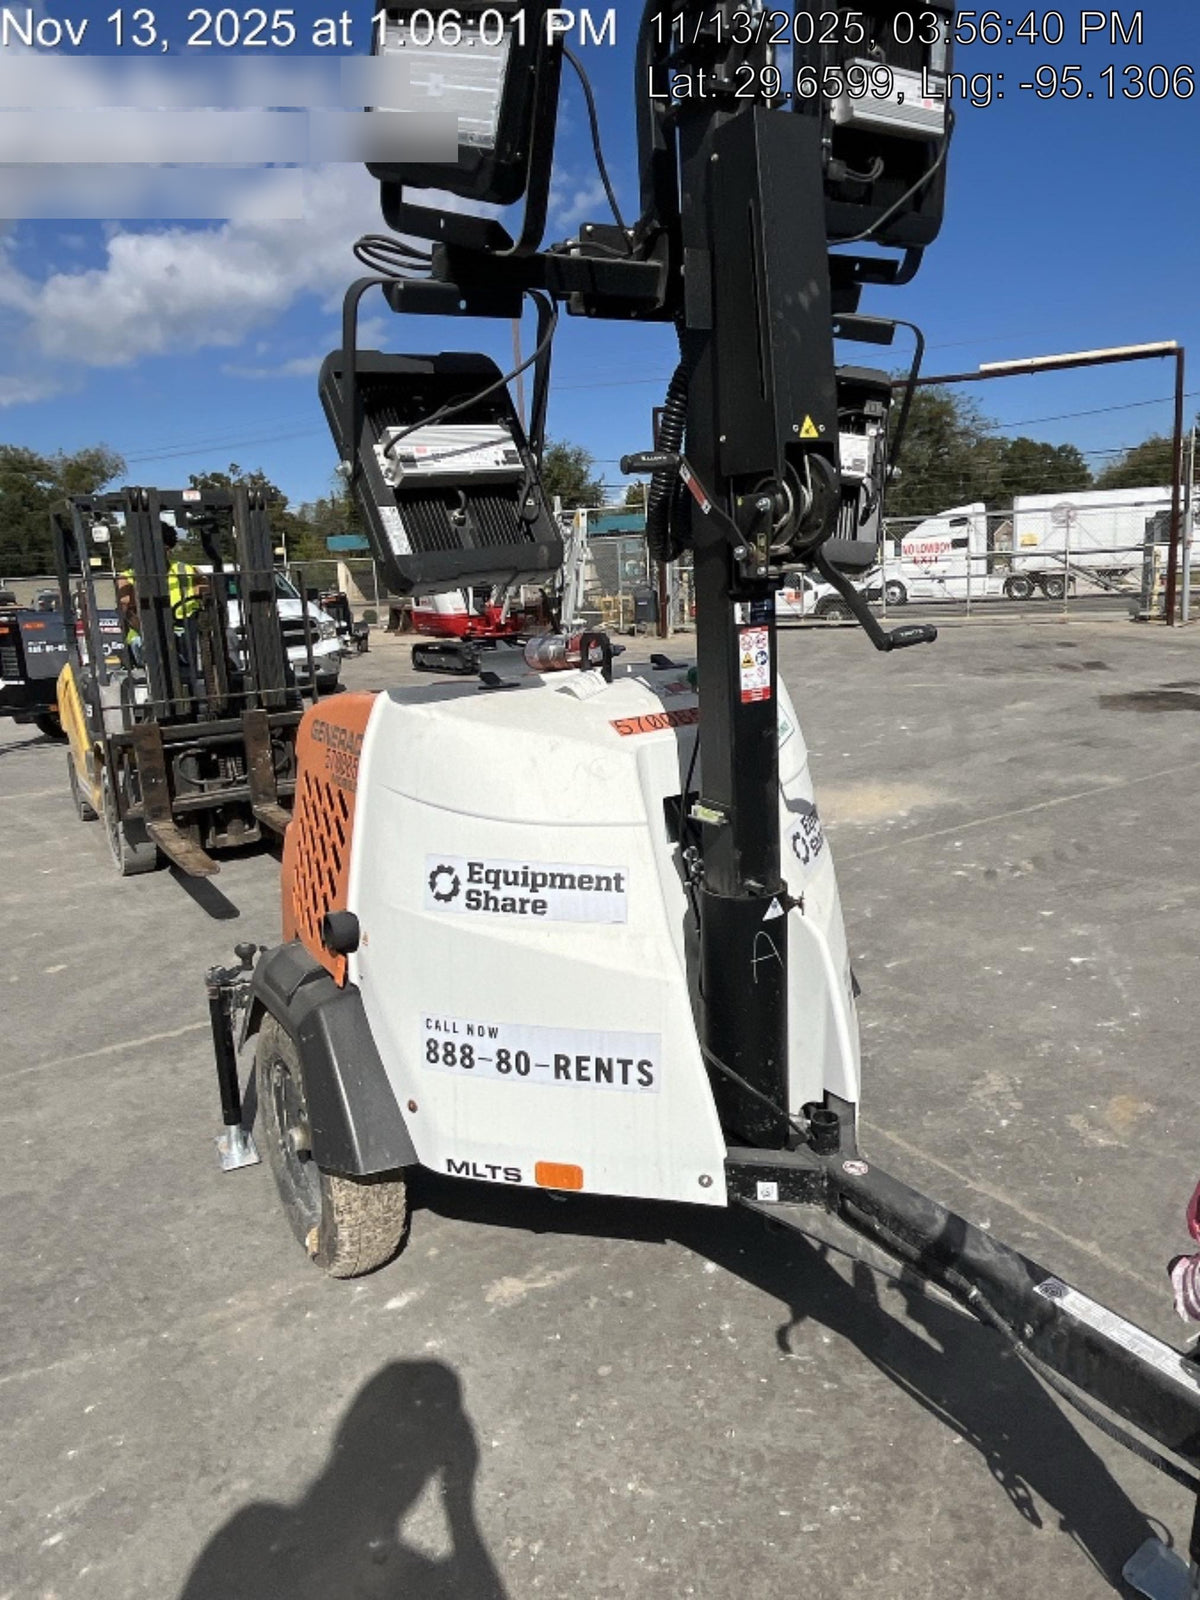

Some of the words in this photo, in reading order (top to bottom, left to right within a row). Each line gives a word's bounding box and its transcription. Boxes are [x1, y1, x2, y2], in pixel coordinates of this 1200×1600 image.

[311, 719, 365, 756] GENERAC
[467, 862, 625, 893] Equipment
[465, 888, 548, 915] Share
[425, 1018, 459, 1034] CALL
[467, 1024, 499, 1039] NOW
[425, 1037, 654, 1087] 888-80-RENTS
[446, 1158, 522, 1182] MLTS
